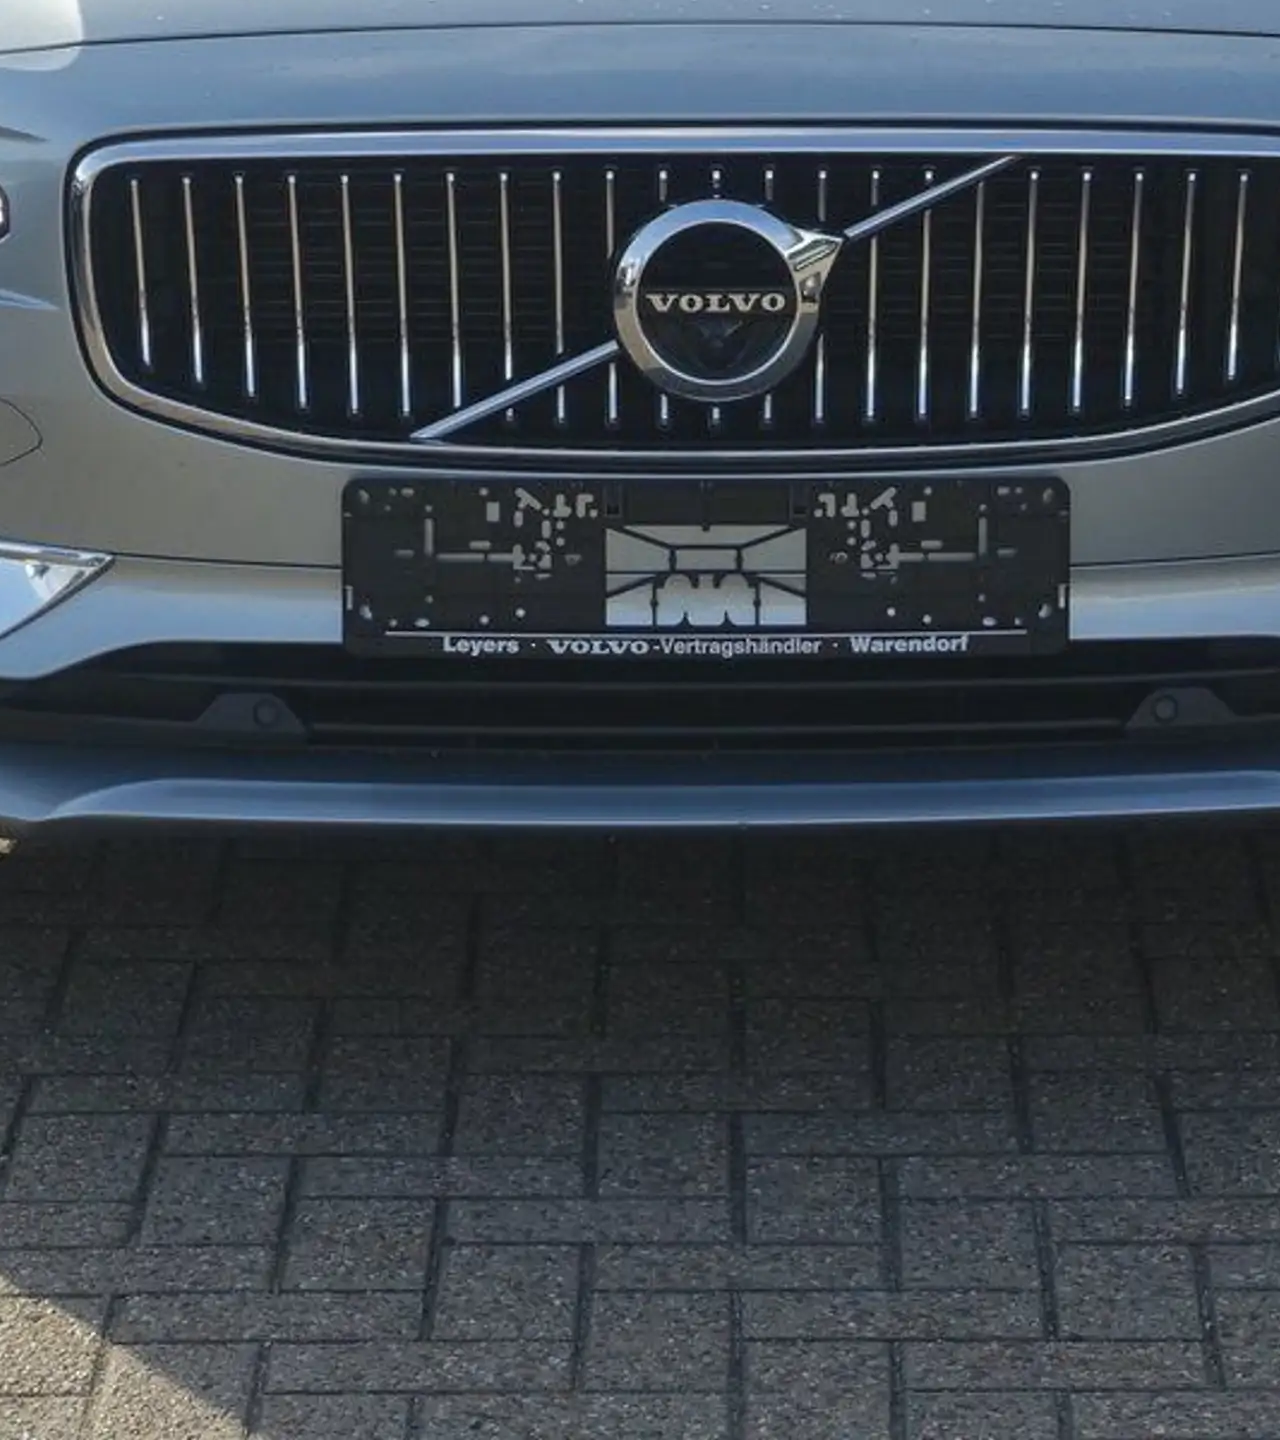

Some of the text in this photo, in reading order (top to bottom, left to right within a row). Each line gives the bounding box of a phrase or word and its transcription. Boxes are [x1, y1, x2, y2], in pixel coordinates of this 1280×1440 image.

[646, 292, 786, 314] VOLVO
[442, 636, 520, 656] Leyers
[849, 635, 969, 653] Warendorf
